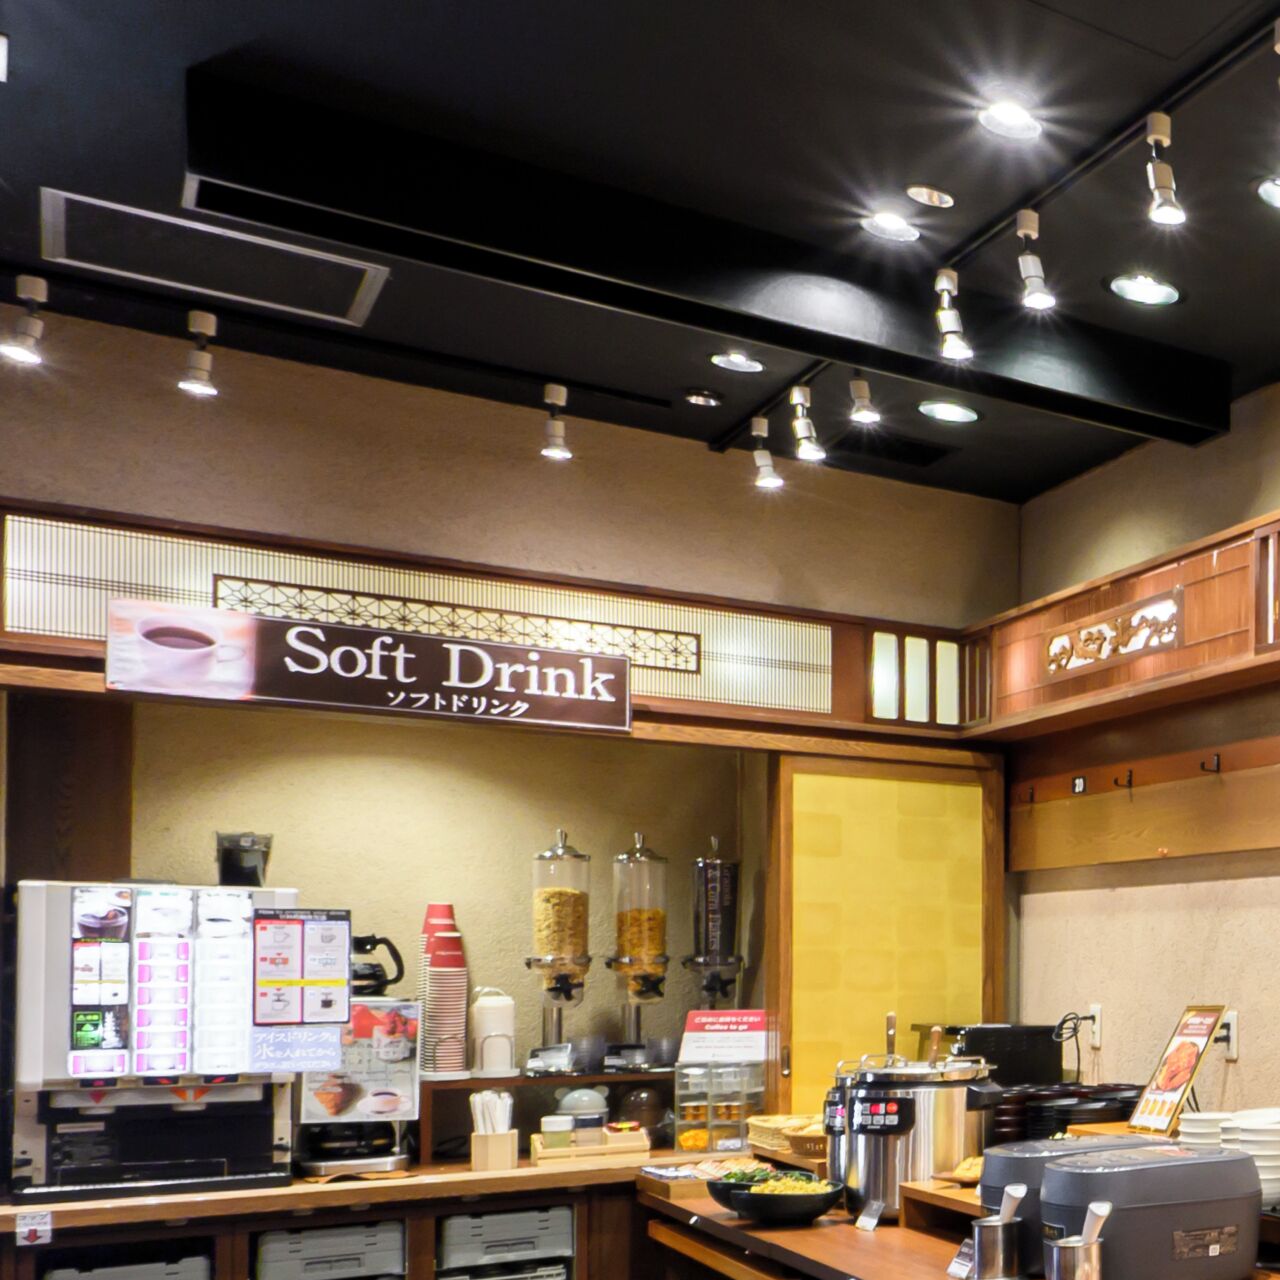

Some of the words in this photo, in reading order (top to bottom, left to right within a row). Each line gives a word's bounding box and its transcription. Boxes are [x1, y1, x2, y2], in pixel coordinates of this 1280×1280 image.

[284, 625, 417, 684] Soft
[442, 643, 616, 702] Drink
[387, 691, 530, 718] ソフトドリンク
[708, 913, 721, 951] Flakes
[729, 1023, 737, 1031] to
